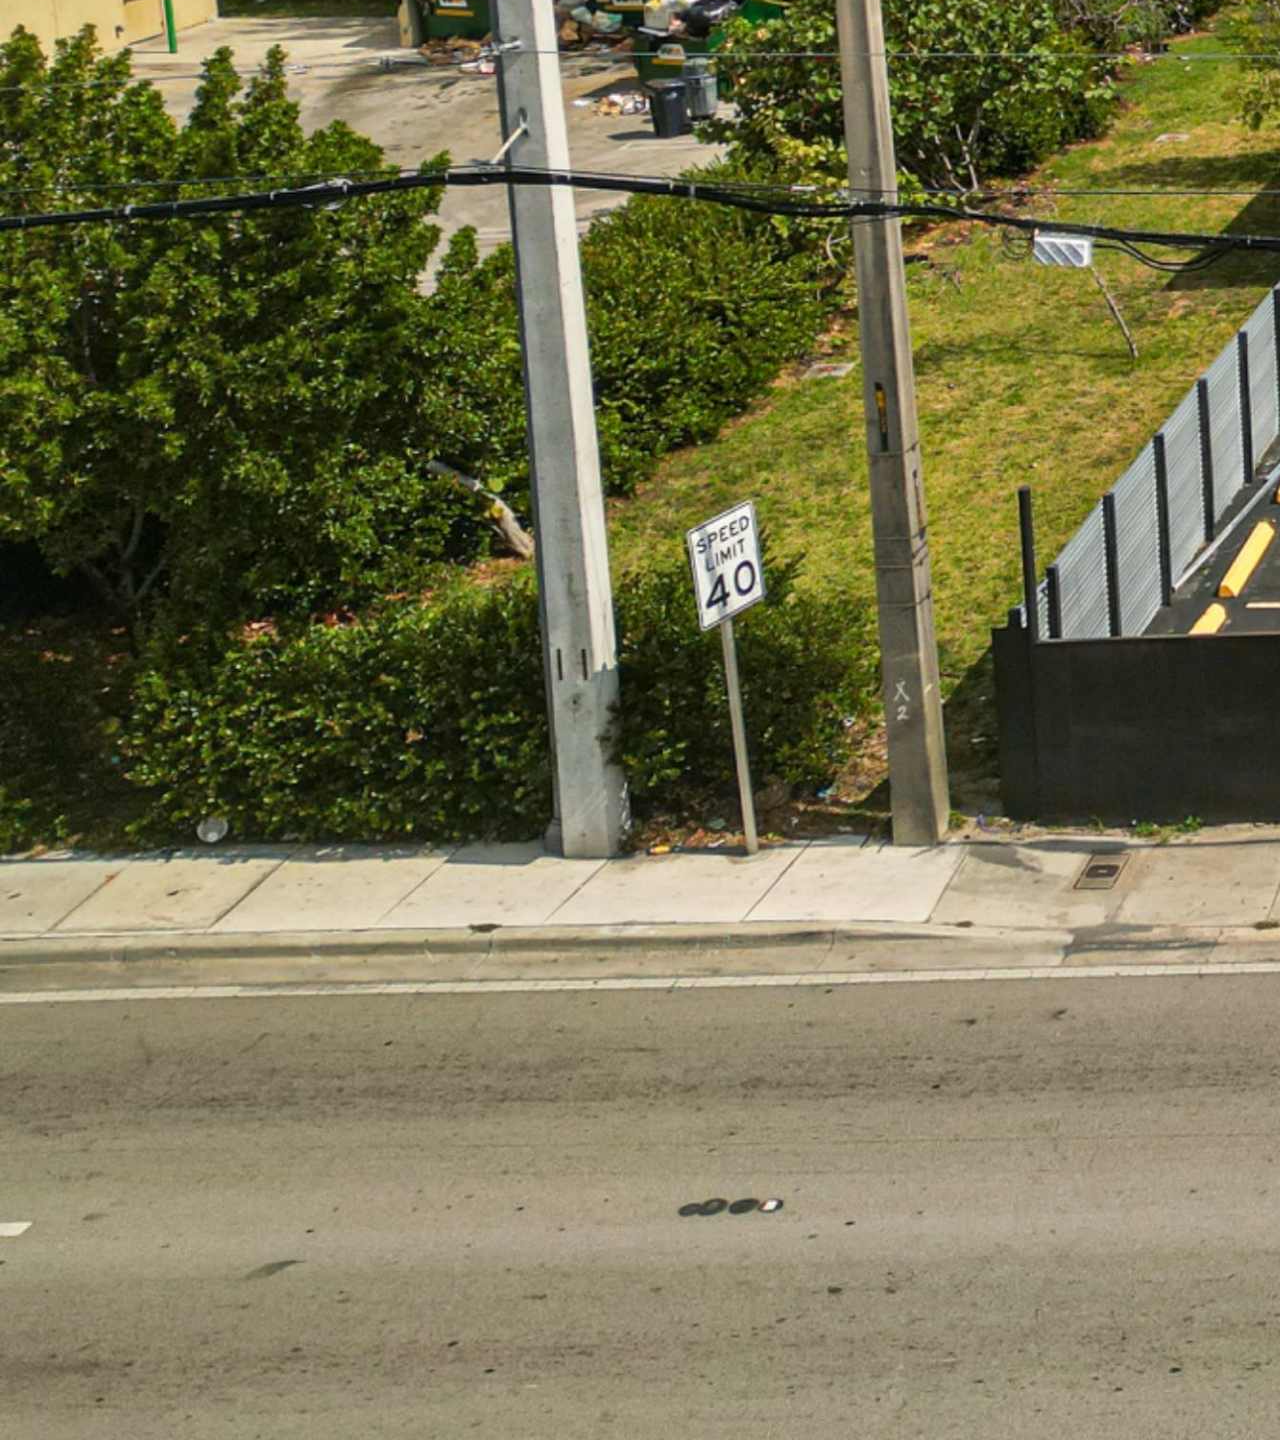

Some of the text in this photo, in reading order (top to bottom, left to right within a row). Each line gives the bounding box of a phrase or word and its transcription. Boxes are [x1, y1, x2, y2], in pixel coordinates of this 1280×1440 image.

[695, 515, 751, 554] SPEED
[704, 537, 746, 573] LIMIT
[705, 559, 756, 610] 40
